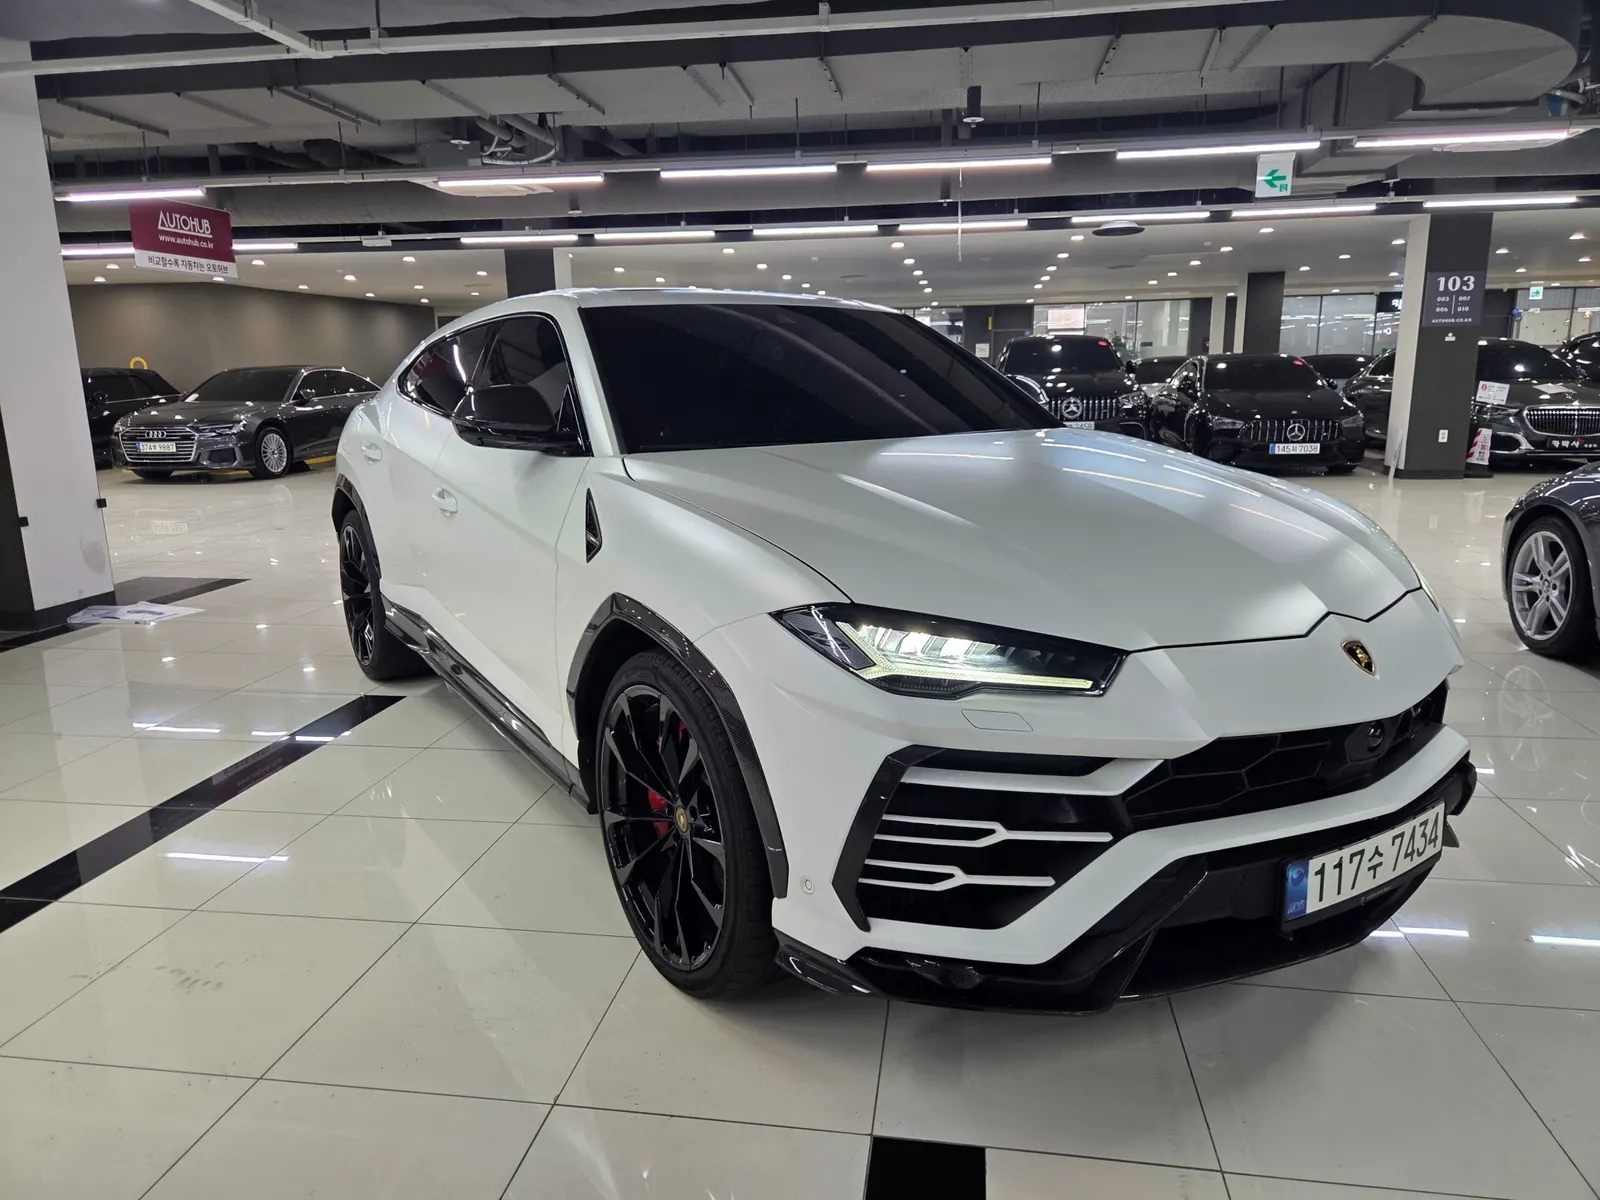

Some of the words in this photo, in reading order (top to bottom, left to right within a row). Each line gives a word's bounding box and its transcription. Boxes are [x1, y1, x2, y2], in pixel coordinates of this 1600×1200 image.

[158, 210, 212, 235] AUTOHUB
[158, 235, 214, 249] www.autohub.co.kr
[147, 255, 181, 269] 비교할수록
[181, 259, 206, 272] 자동차는
[206, 262, 229, 274] 오토허브
[1437, 275, 1475, 291] 103
[1314, 845, 1384, 903] 117수
[1391, 811, 1441, 872] 7434
